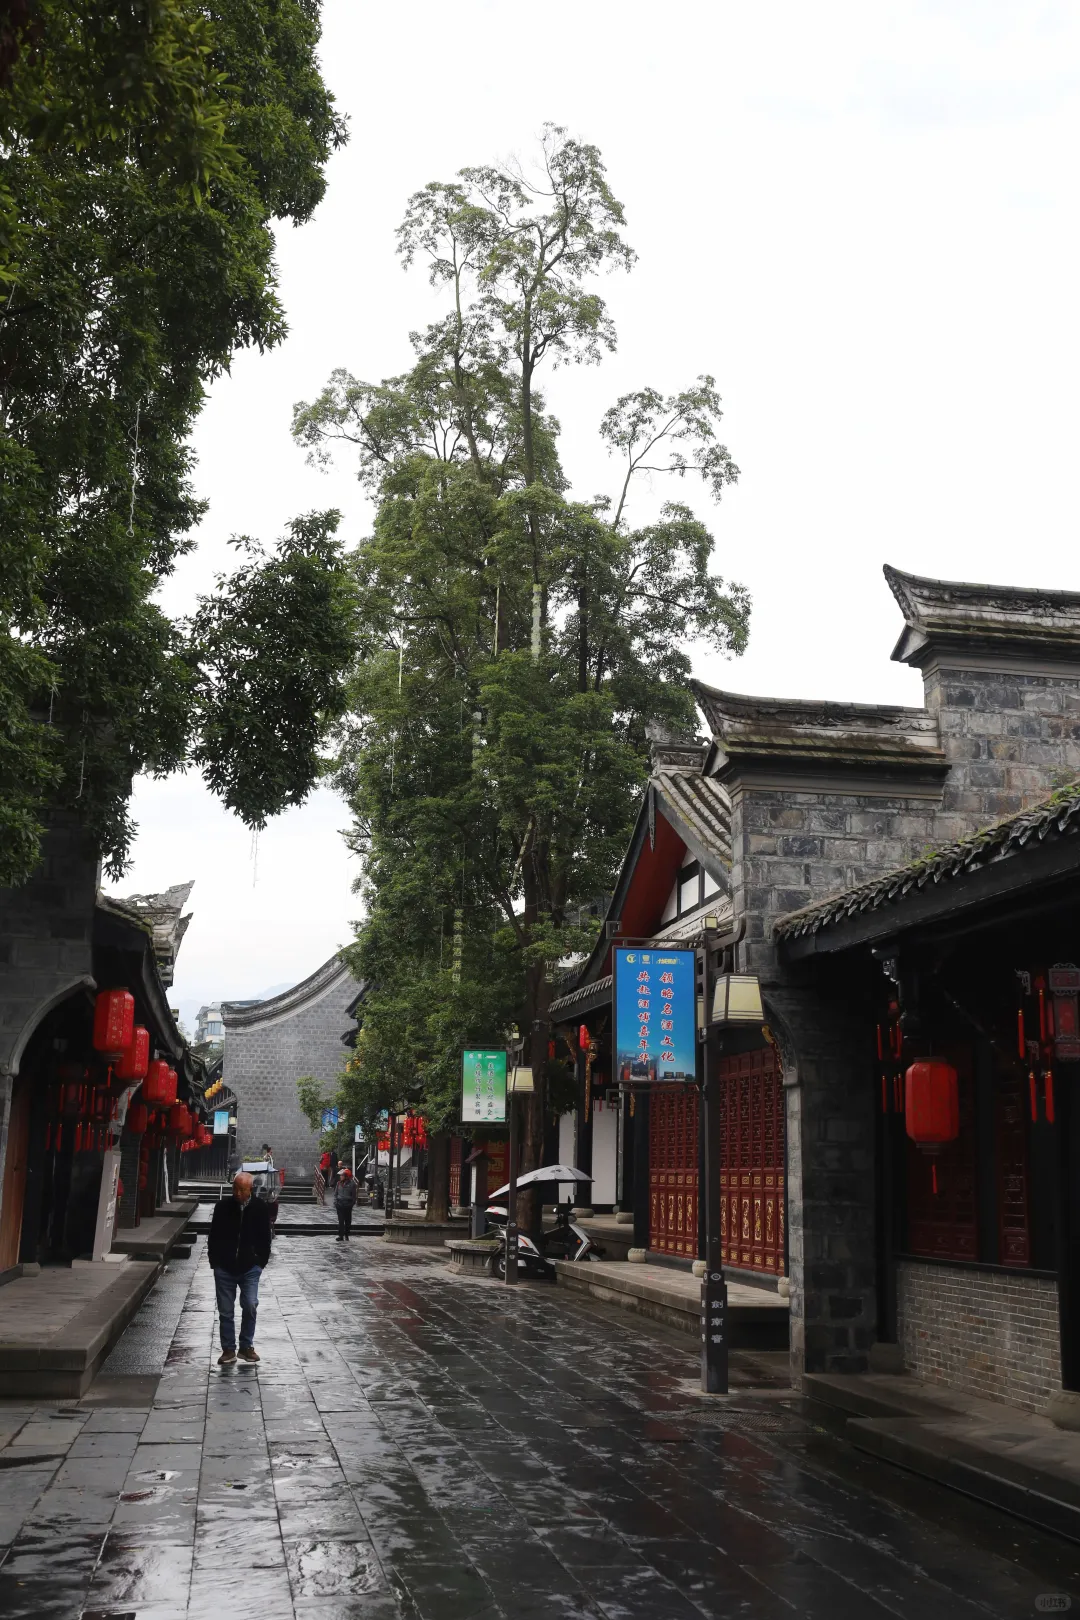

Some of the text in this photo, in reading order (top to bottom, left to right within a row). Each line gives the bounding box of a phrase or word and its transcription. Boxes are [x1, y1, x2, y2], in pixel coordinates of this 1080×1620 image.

[636, 970, 650, 1065] 共赴酒博嘉年华
[658, 971, 675, 1062] 领略名酒文化
